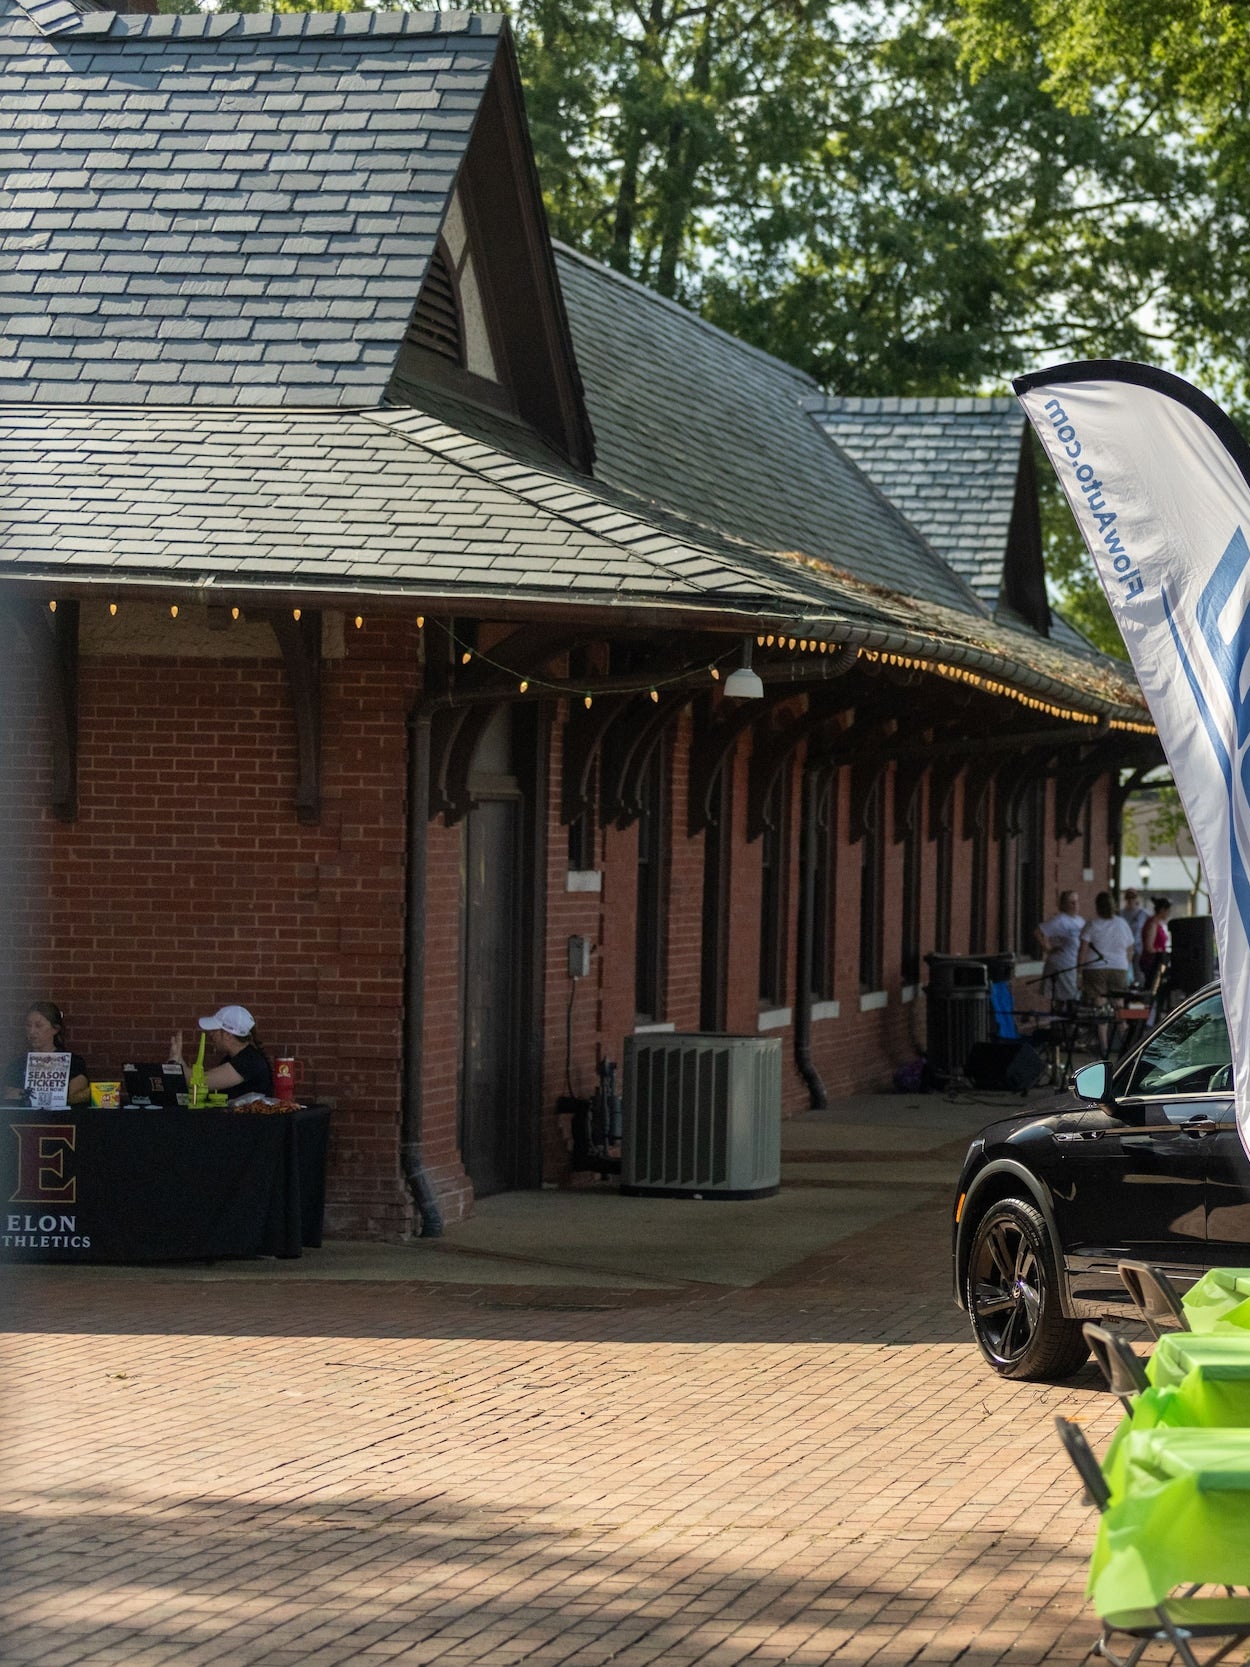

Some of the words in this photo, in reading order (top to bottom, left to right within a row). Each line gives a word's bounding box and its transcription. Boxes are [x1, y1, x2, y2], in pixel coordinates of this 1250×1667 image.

[28, 1071, 67, 1079] SEASON
[28, 1079, 66, 1088] TICKETS
[7, 1214, 77, 1232] ELON
[1, 1235, 91, 1248] THLETICS
